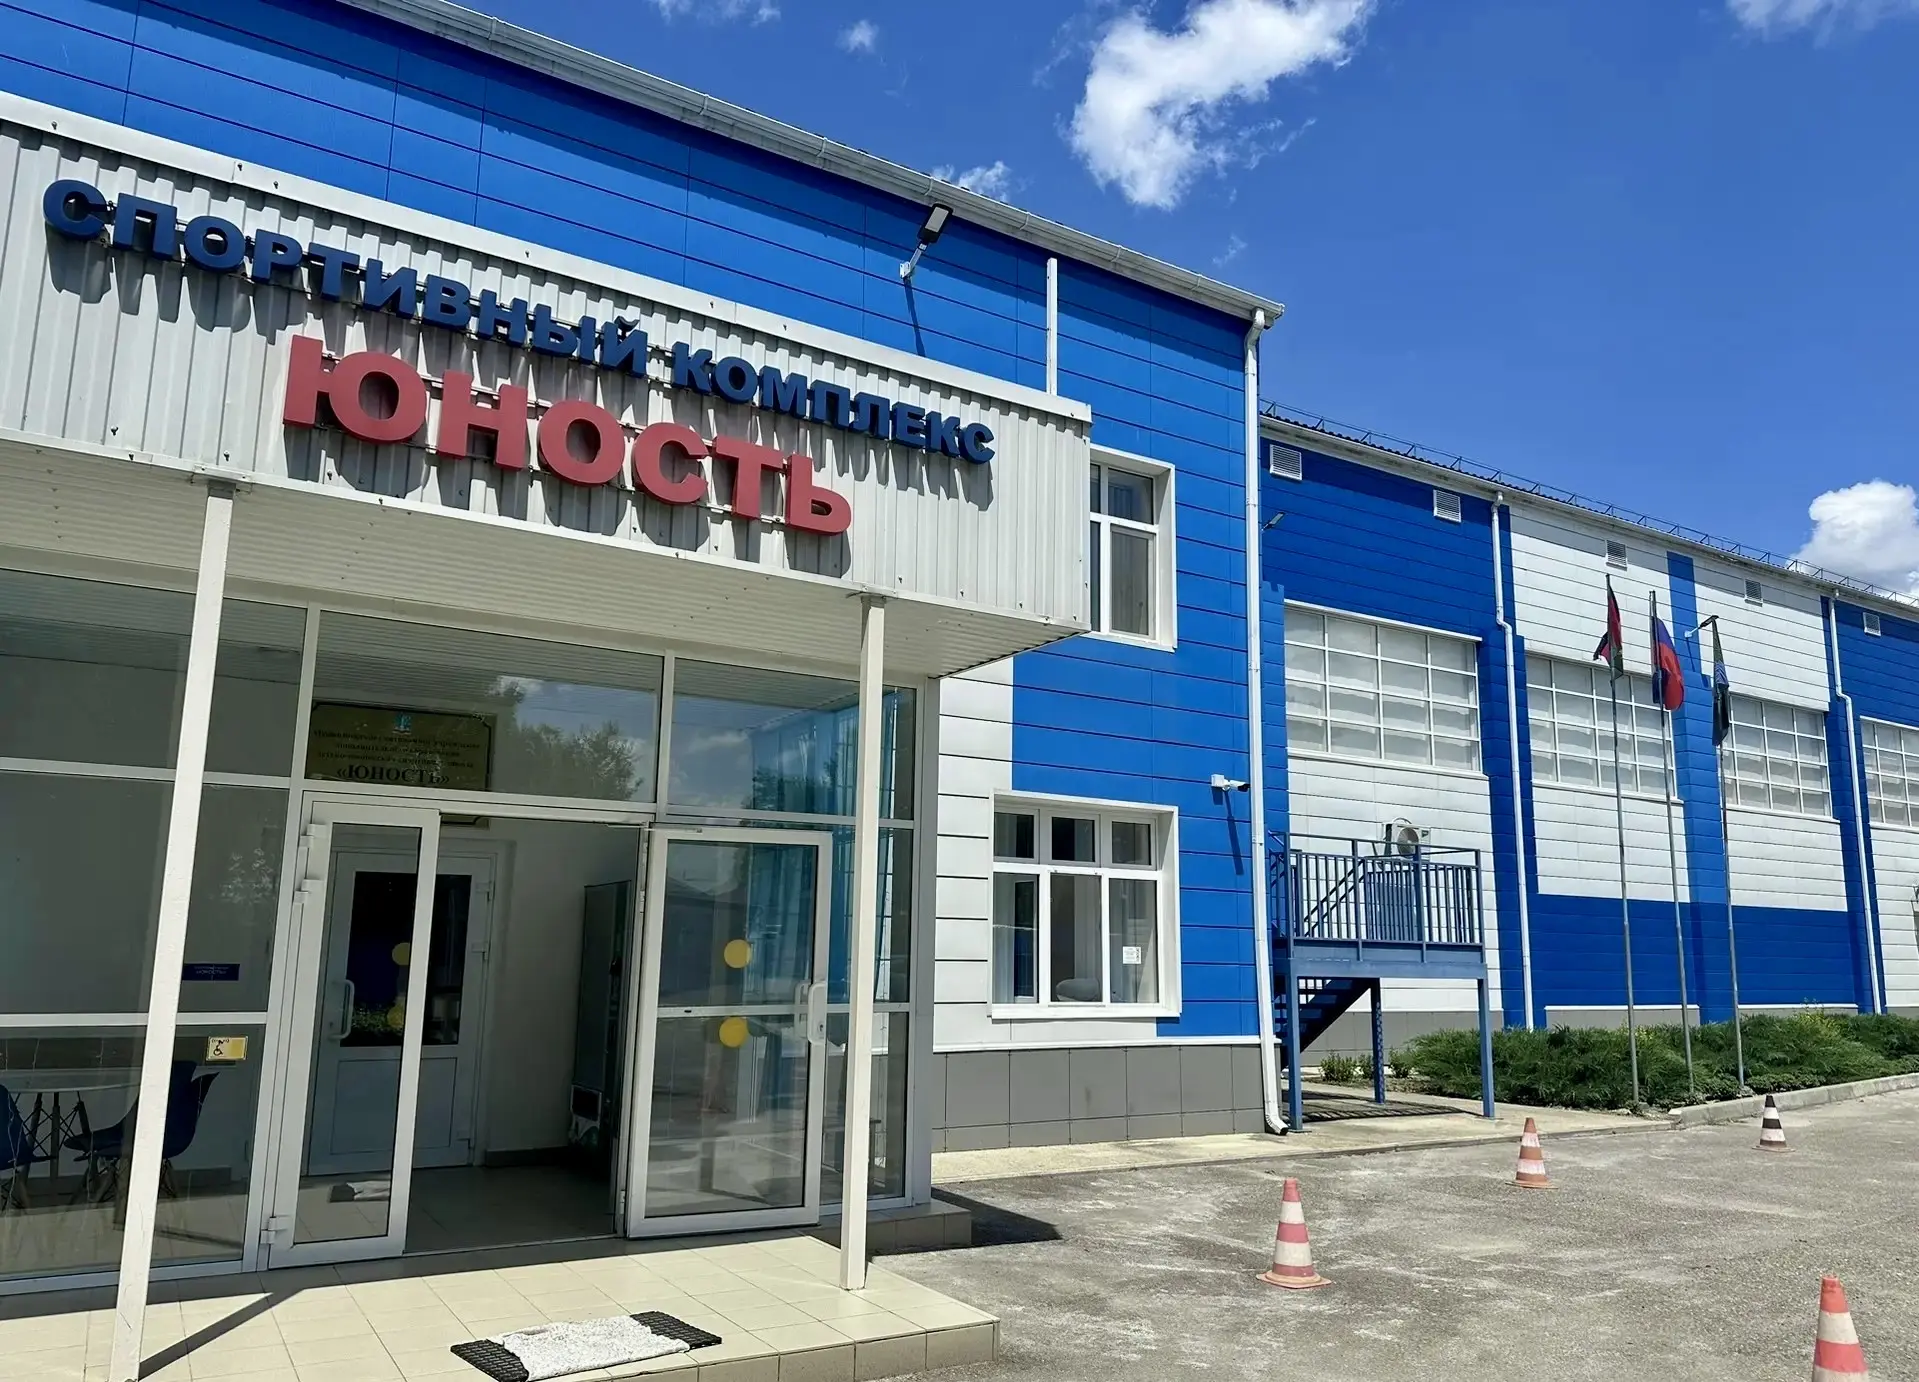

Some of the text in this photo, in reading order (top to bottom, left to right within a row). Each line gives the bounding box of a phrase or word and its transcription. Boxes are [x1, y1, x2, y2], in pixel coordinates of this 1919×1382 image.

[43, 179, 996, 464] СПОРТИВНЫЙ КОМПЛЕКС
[283, 335, 851, 535] ЮНОСТЬ
[337, 763, 450, 784] «ЮНОСТЬ»
